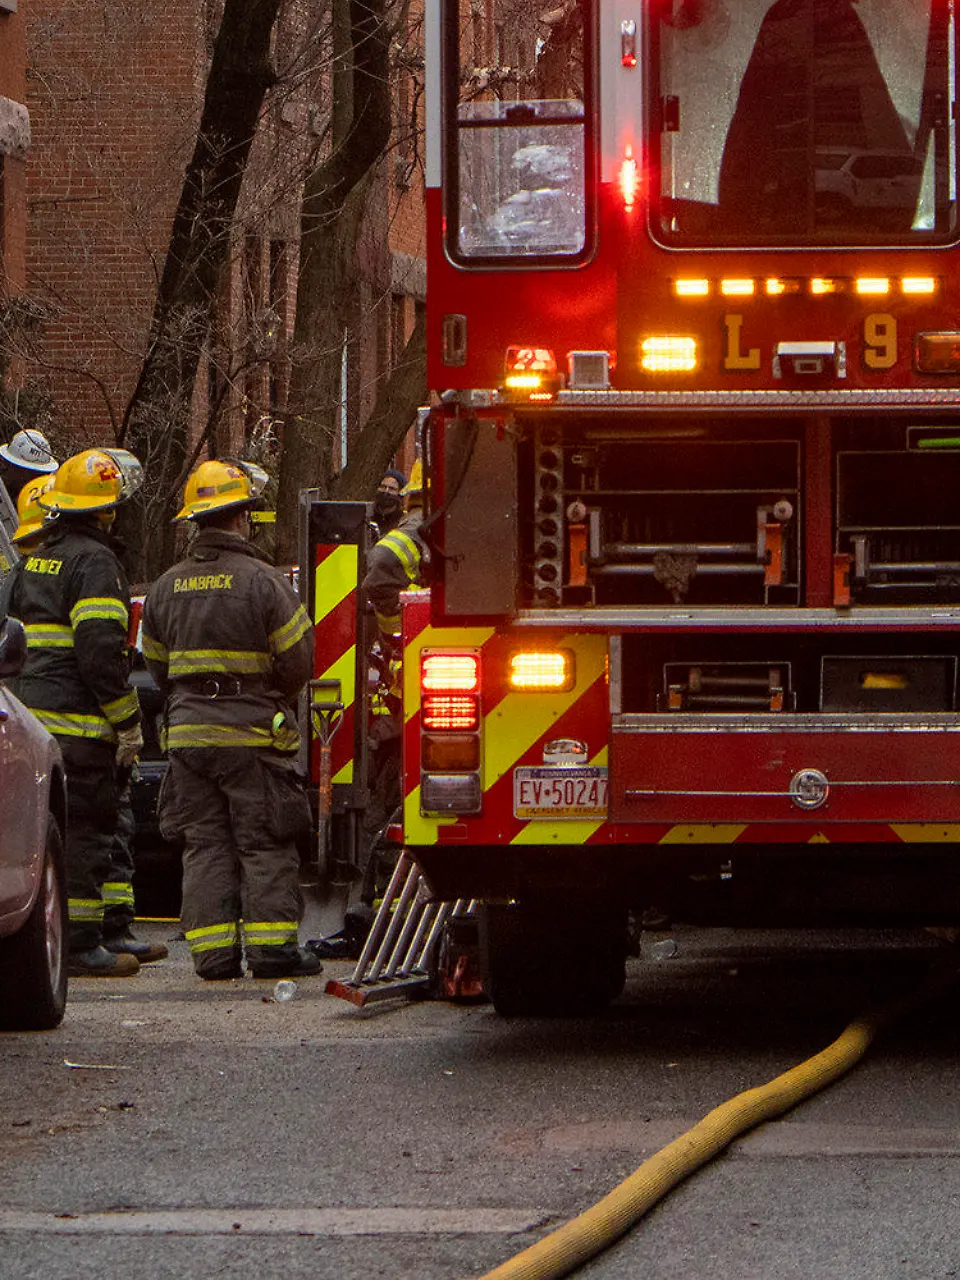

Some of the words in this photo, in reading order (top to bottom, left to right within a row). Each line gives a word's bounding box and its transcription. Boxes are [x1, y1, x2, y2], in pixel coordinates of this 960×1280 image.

[723, 313, 761, 370] L
[864, 313, 898, 369] 9
[173, 573, 234, 594] BAMBRICK
